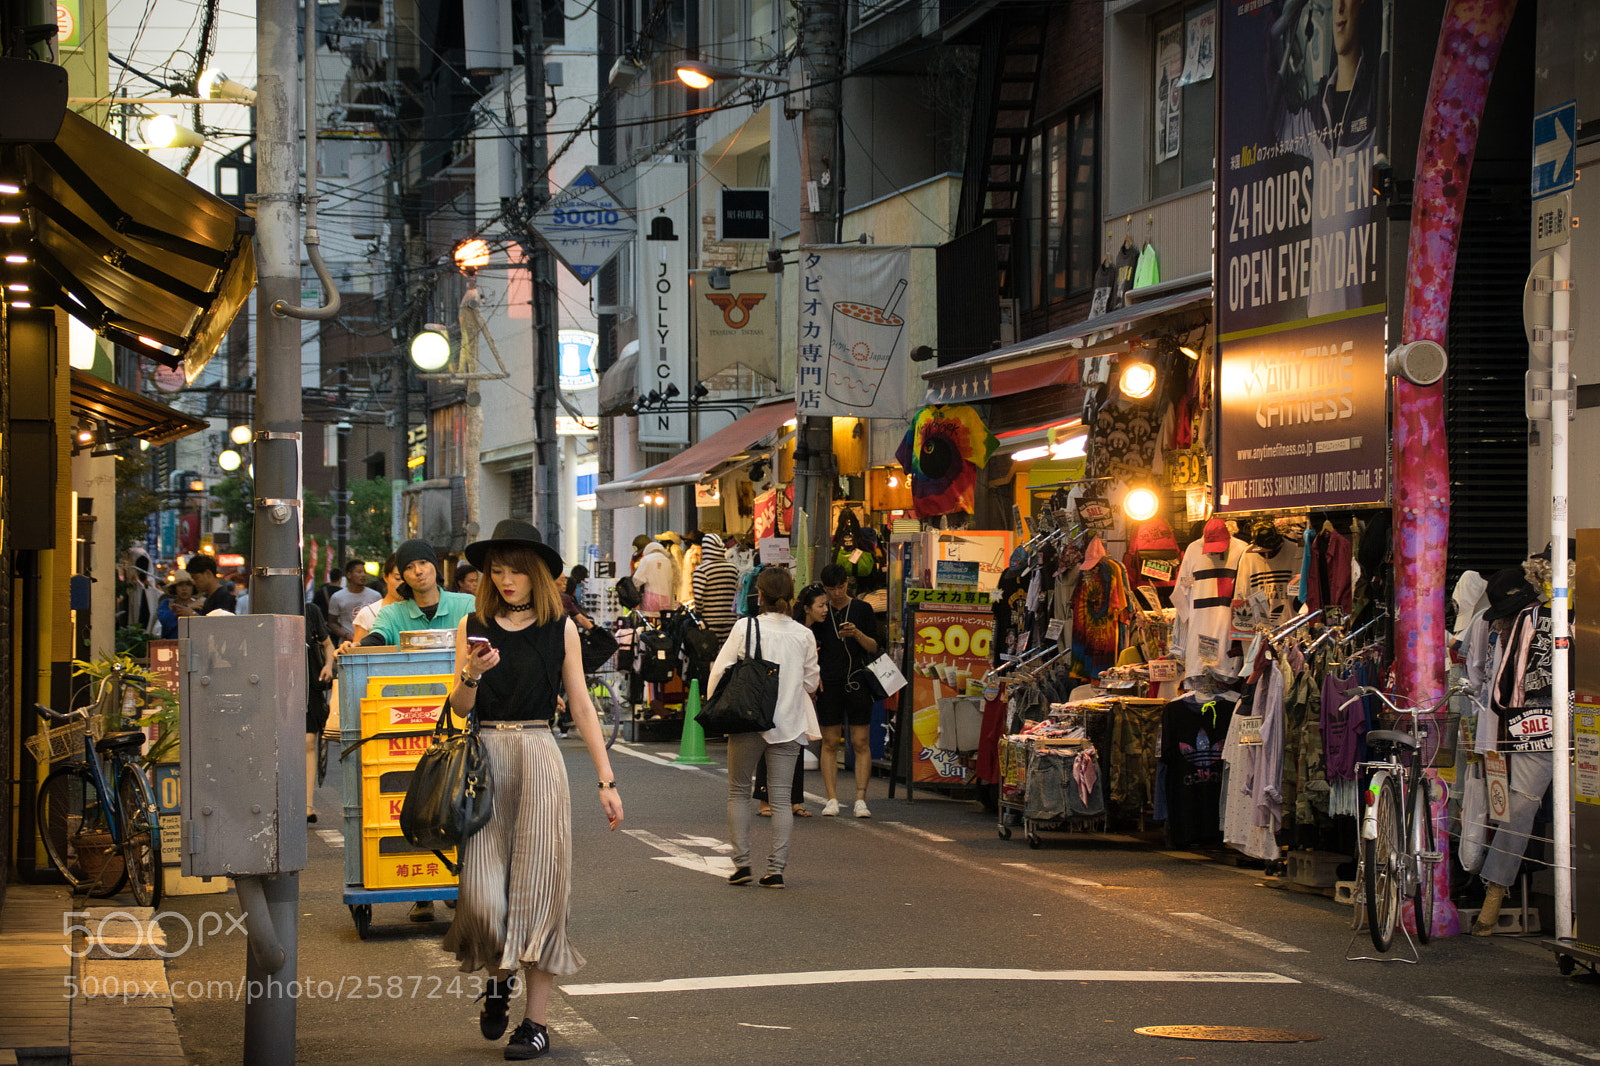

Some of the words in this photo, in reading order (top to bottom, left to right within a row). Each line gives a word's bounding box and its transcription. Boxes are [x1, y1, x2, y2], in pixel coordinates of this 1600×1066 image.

[552, 208, 619, 226] SOCIO
[1229, 247, 1273, 312] OPEN
[1277, 221, 1378, 302] EVERYDAY!
[656, 262, 671, 344] JOLLY
[799, 252, 823, 409] タピオカ専門店
[1266, 385, 1354, 428] FITNESS
[1237, 439, 1313, 462] www.anytimefitness.co.jp
[1222, 480, 1247, 499] ANYTIME
[1249, 477, 1274, 498] FITNESS
[1275, 473, 1318, 496] SHINSAIBASHI
[1325, 469, 1351, 493] BRUTUS
[1352, 468, 1373, 490] Build.
[1374, 468, 1383, 489] 3F
[1086, 506, 1103, 517] SALE
[1521, 717, 1550, 735] SALE
[395, 862, 440, 878] 菊正宗
